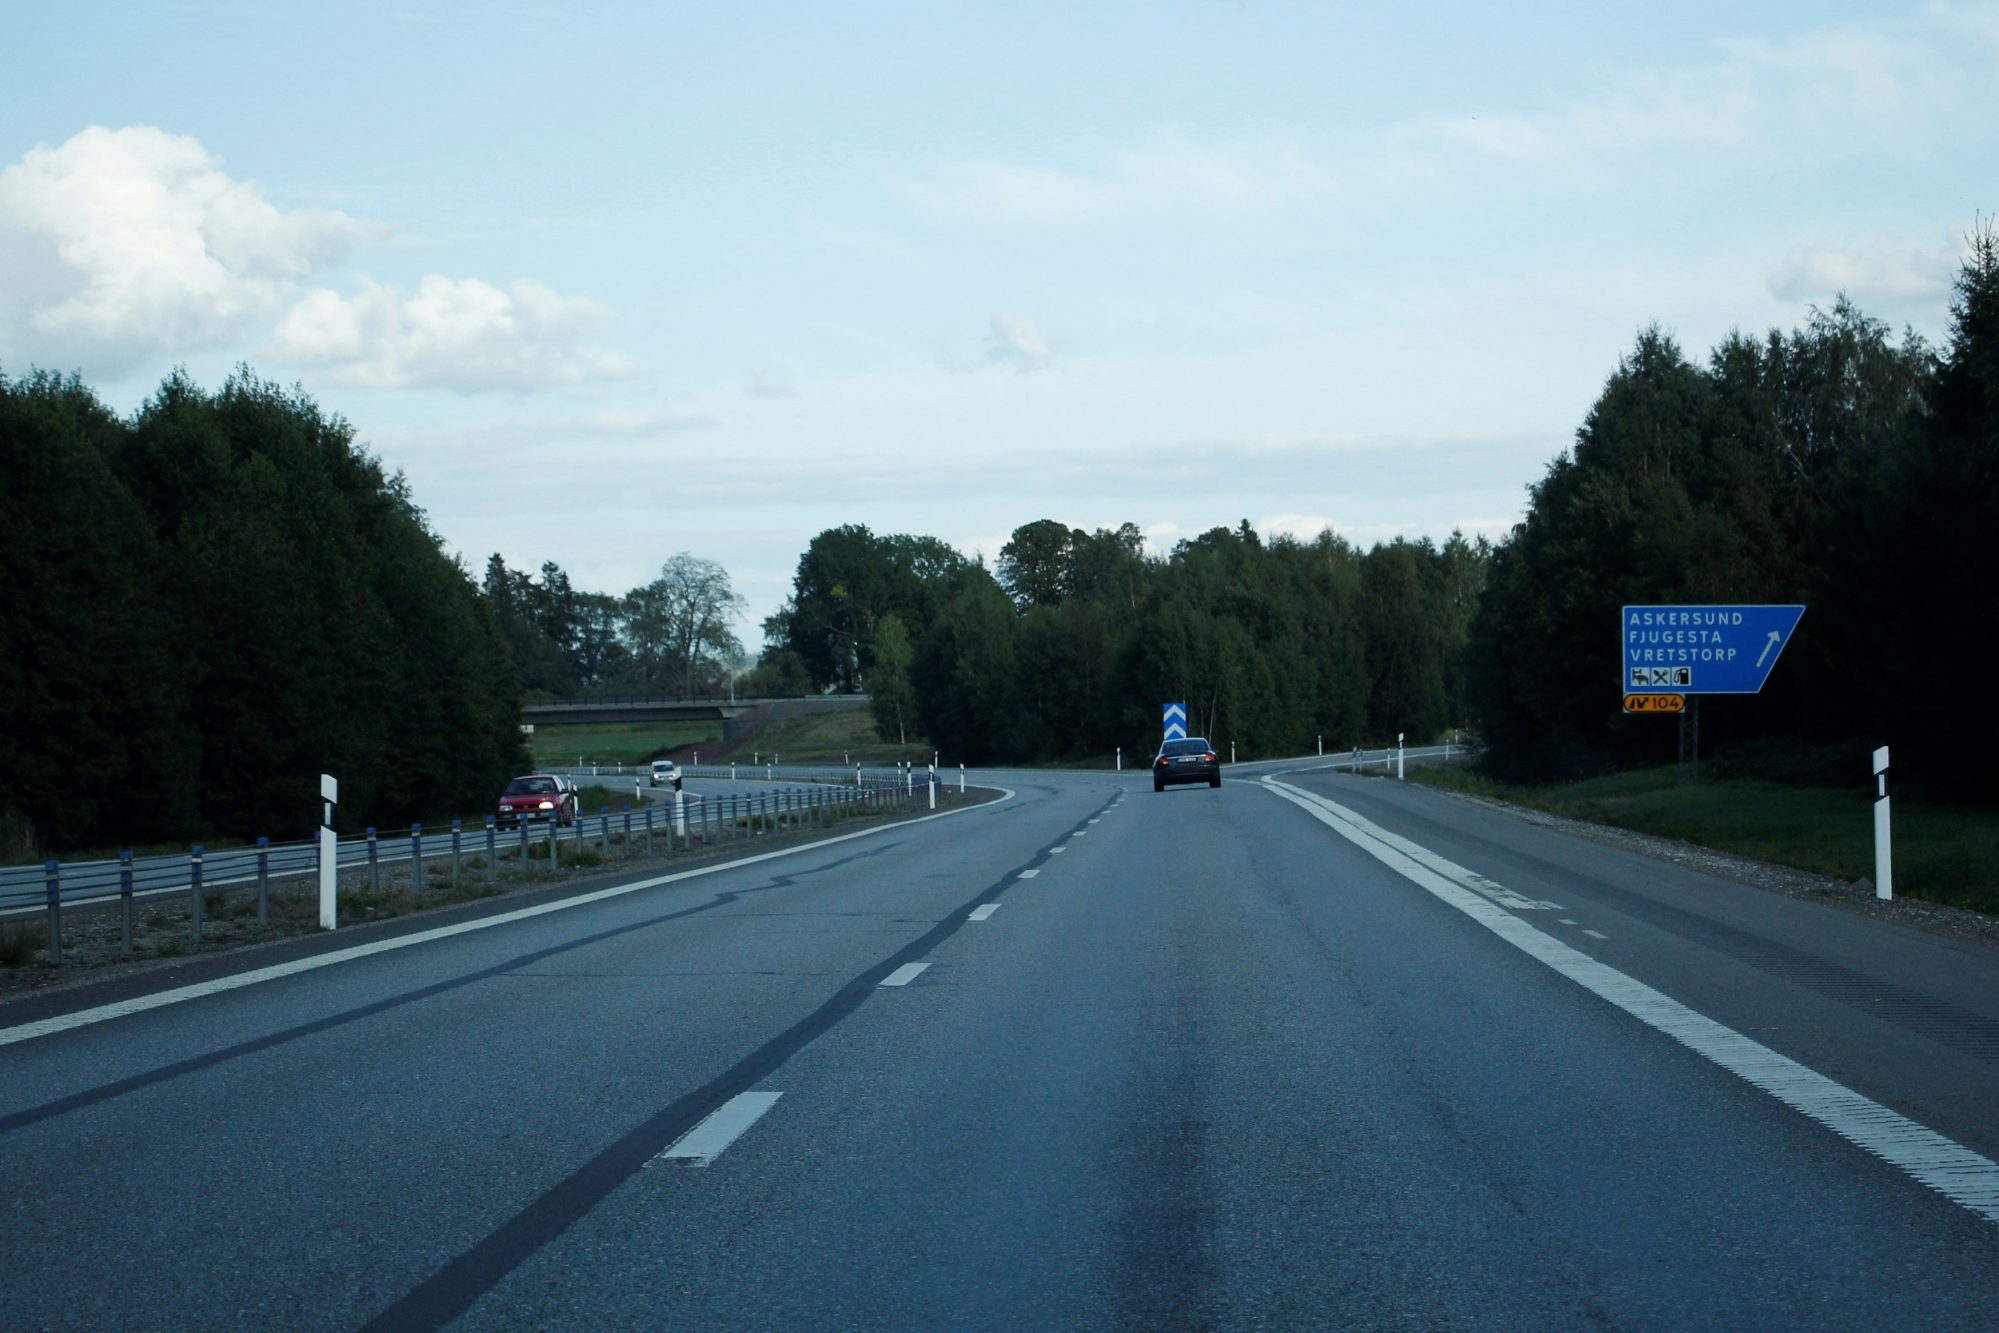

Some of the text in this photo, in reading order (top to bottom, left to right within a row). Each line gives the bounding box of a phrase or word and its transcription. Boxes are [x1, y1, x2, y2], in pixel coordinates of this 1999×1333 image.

[1629, 612, 1743, 626] ASKERSUND
[1629, 630, 1722, 644] FJUGESTA
[1629, 648, 1737, 662] VRETSTORP
[1652, 696, 1680, 710] 104
